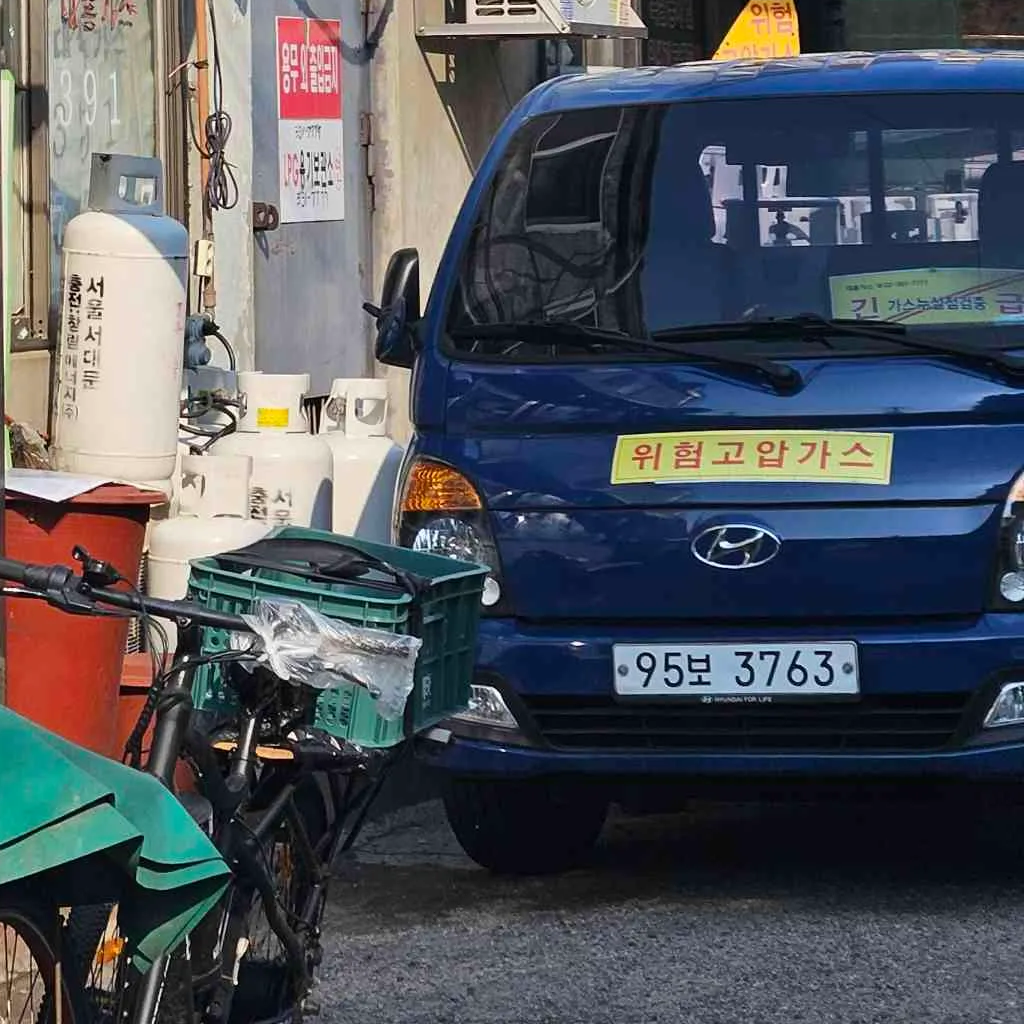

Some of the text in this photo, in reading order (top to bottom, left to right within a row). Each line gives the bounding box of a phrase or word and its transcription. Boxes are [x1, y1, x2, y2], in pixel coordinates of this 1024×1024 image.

[59, 69, 121, 127] 391
[635, 650, 834, 688] 95보 3763
